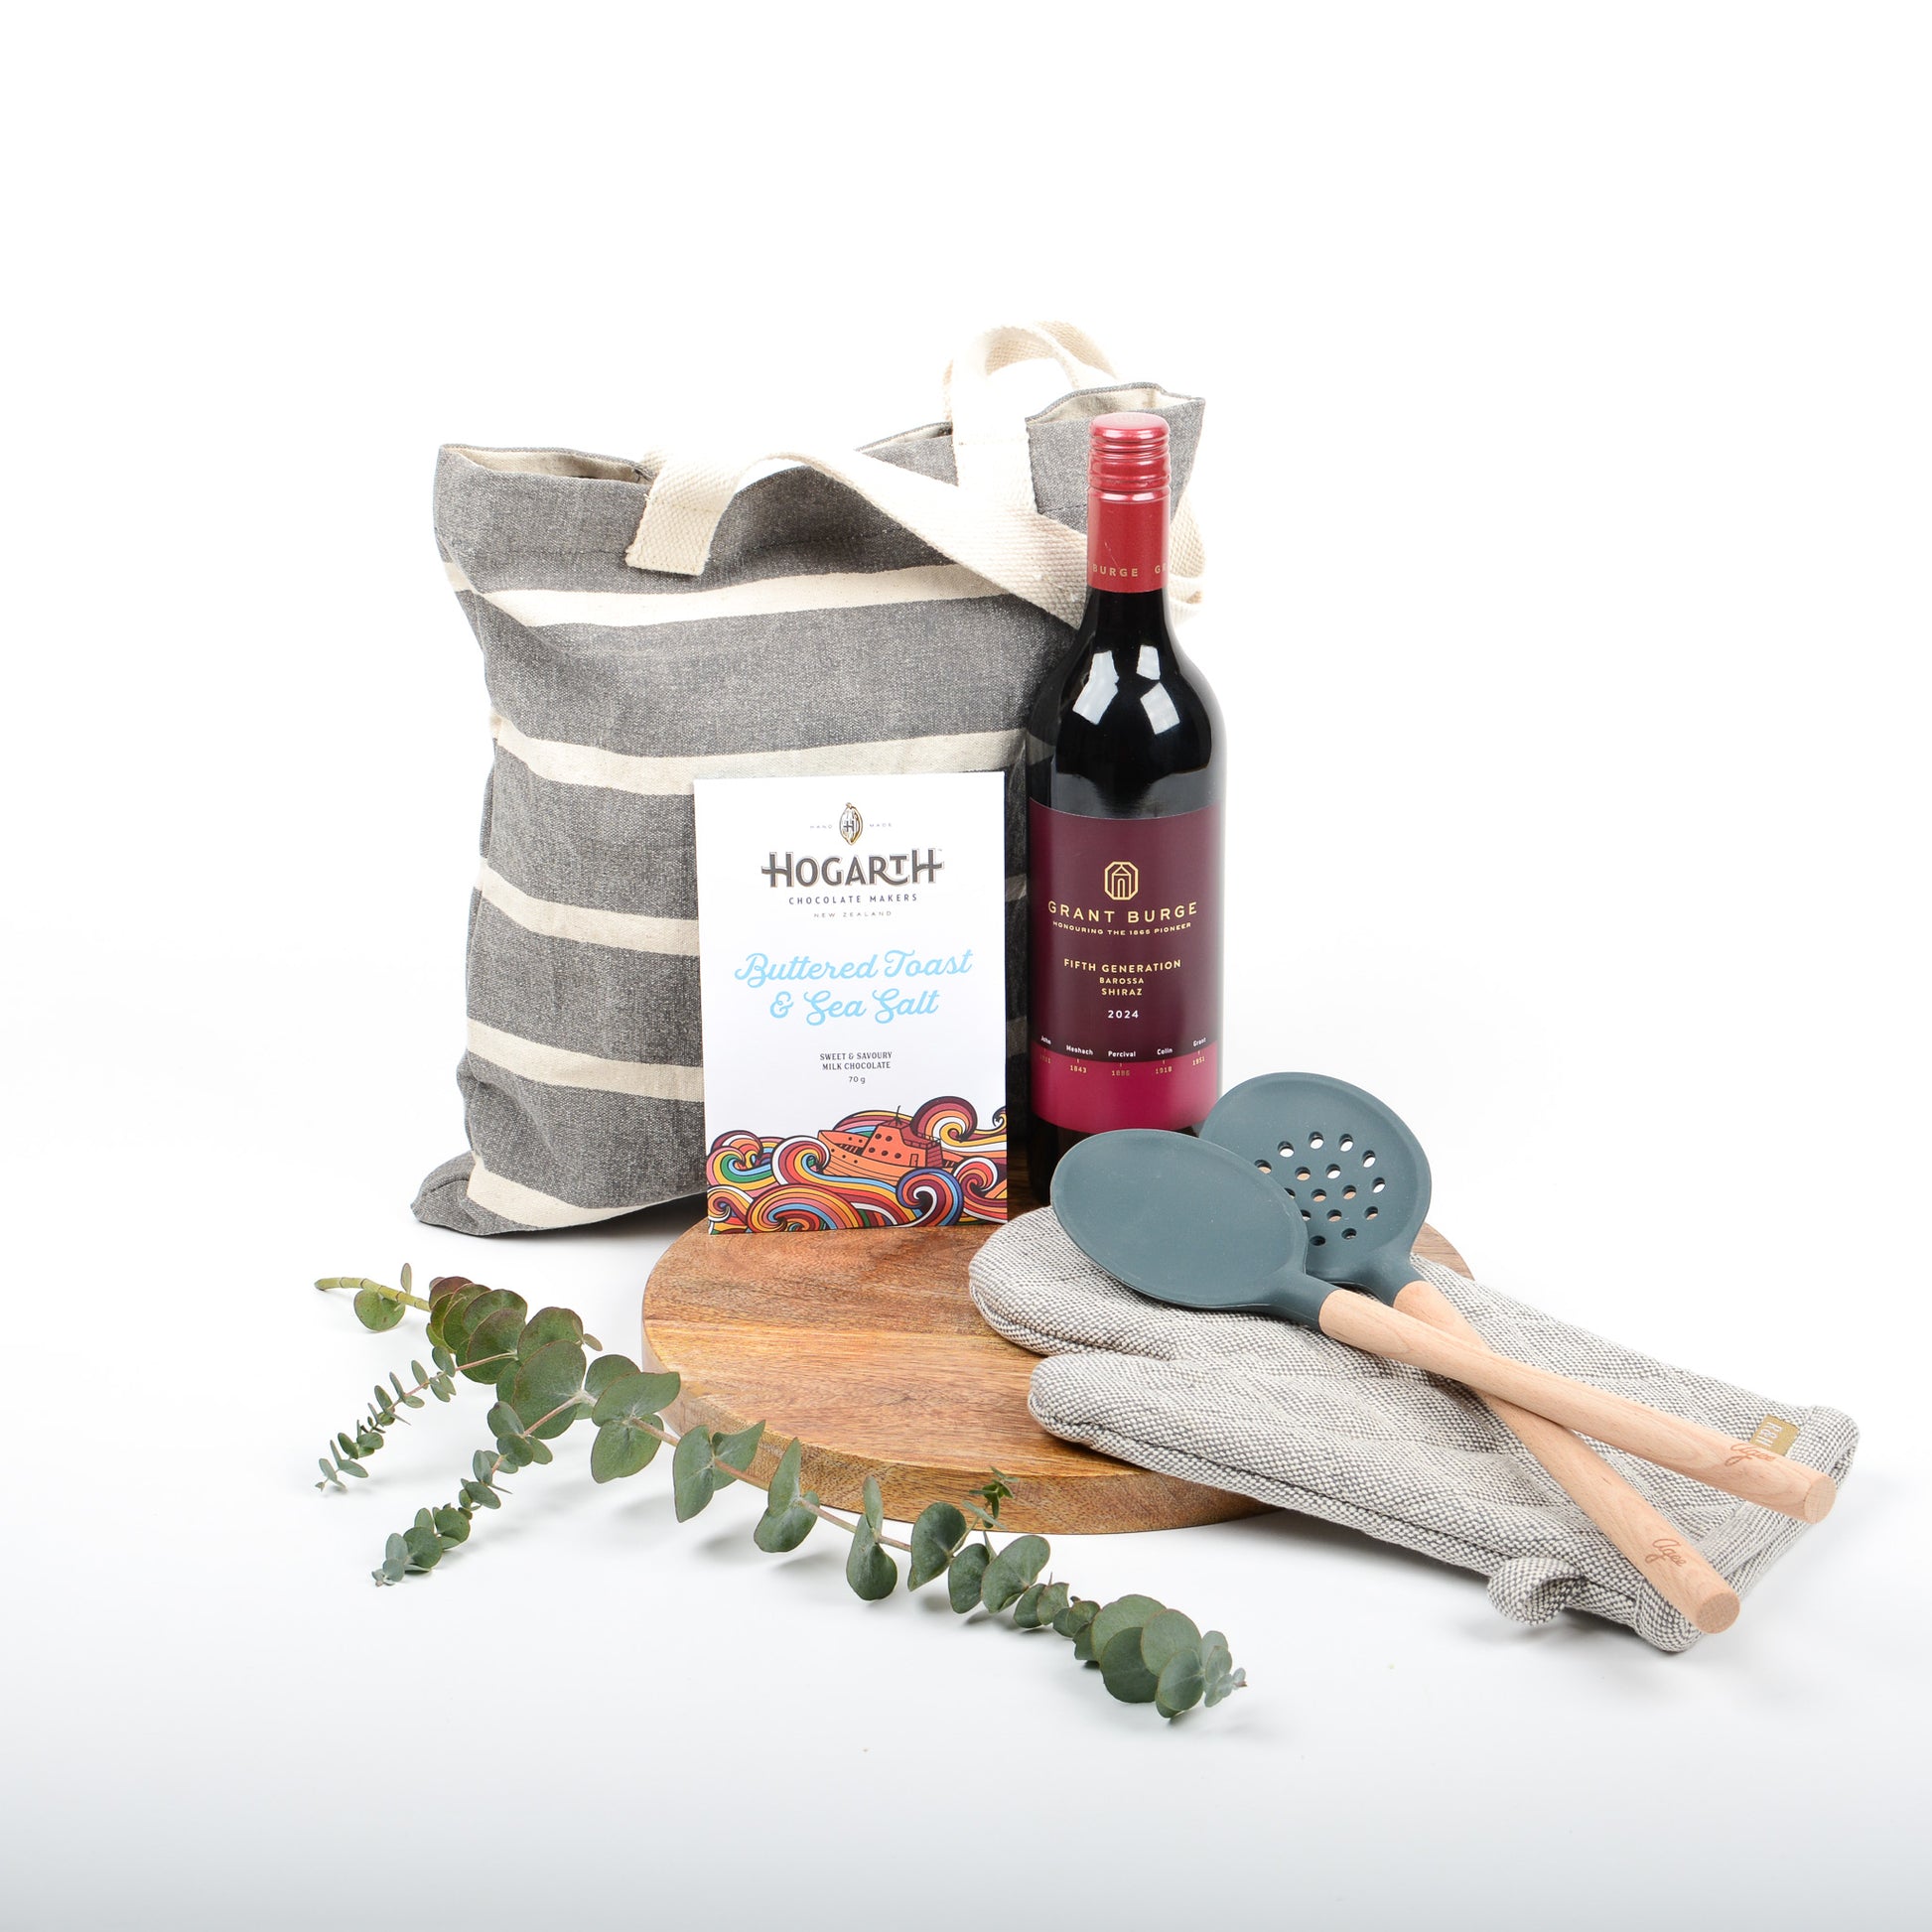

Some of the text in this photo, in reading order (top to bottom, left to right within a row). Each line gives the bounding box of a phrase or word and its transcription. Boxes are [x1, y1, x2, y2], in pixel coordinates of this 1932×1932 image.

[1091, 563, 1139, 577] BURGE
[760, 848, 944, 888] HOGARTH
[788, 894, 917, 904] CHOCOLATE MAKERS
[1047, 900, 1197, 923] GRANT BURGE
[1052, 920, 1104, 935] HONOURING
[1154, 922, 1191, 934] PIONEER
[734, 948, 973, 988] Buttered Toast
[1063, 958, 1181, 973] FIFTH GENERATION
[1099, 976, 1144, 985] BAROSSA
[1101, 987, 1143, 996] SHIRAZ
[769, 988, 940, 1026] & Sea Salt
[1107, 1010, 1139, 1019] 2024
[1192, 1036, 1206, 1048] Grant
[844, 1061, 892, 1070] CHOCOLATE
